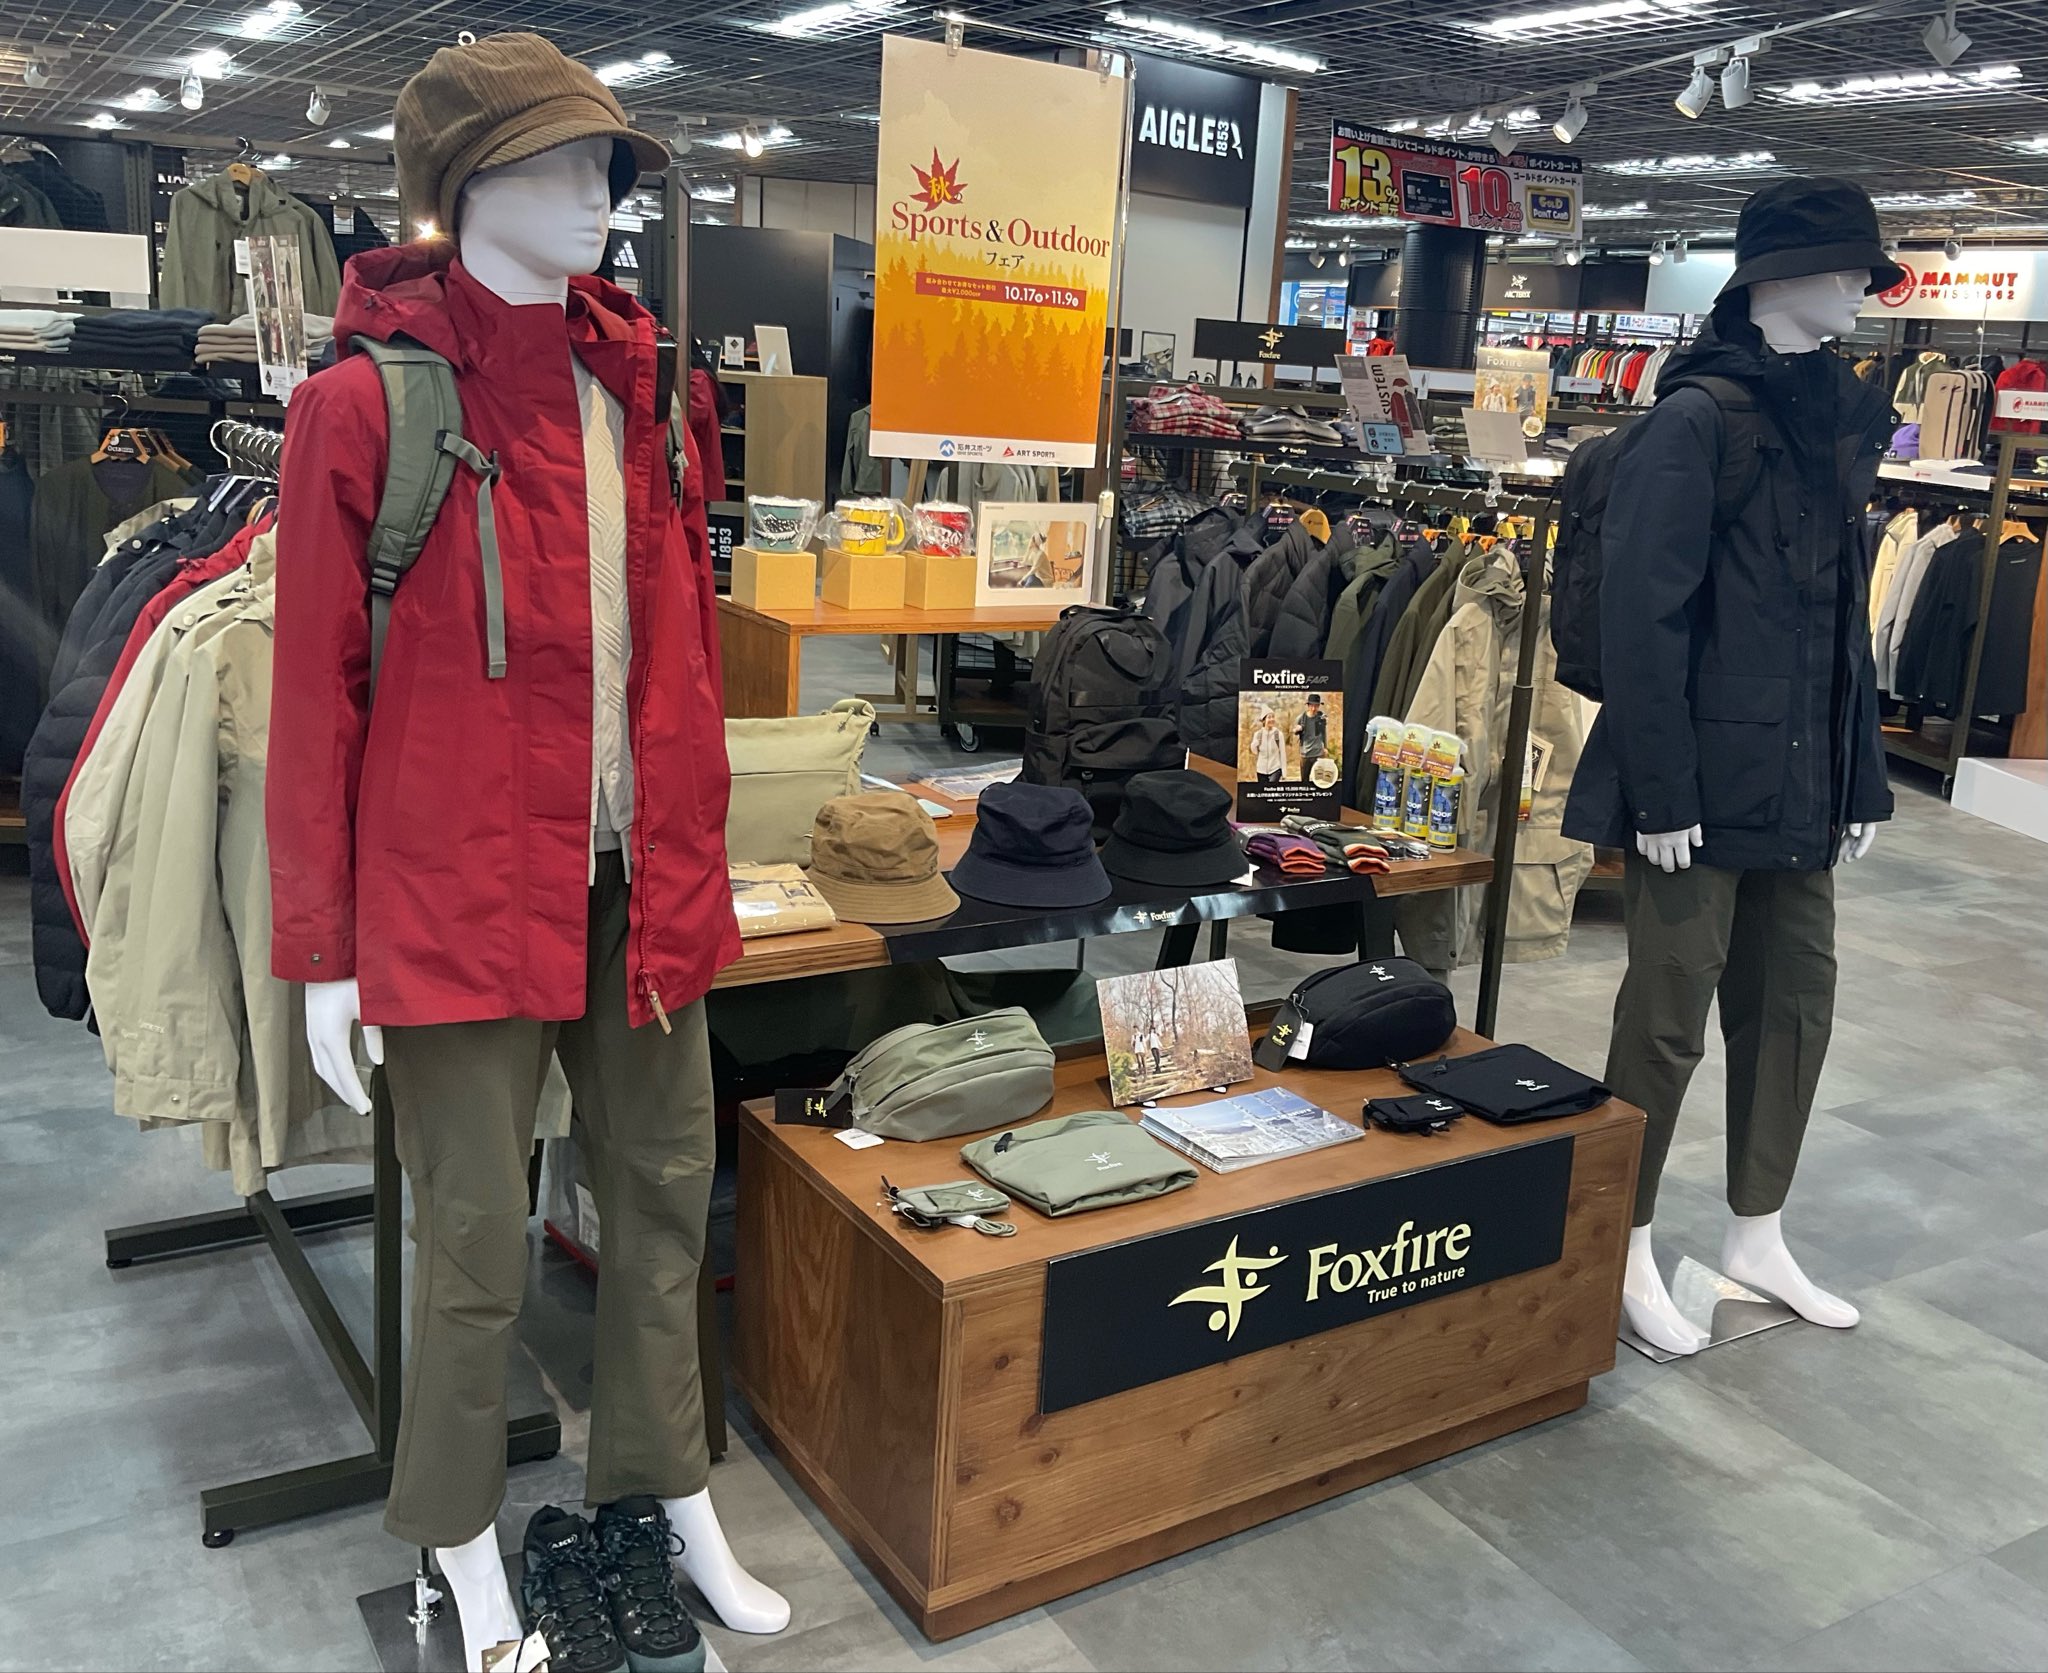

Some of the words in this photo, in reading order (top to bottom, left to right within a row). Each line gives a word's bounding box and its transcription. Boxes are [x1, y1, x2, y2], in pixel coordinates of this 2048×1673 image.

[1139, 106, 1216, 155] AIGLE
[1215, 121, 1230, 157] 1853
[1336, 145, 1400, 204] 13%
[1459, 166, 1523, 221] 10%
[891, 201, 982, 242] Sports
[986, 219, 1004, 244] &
[1007, 218, 1110, 258] Outdoor
[986, 252, 1025, 269] フェア
[1921, 272, 2018, 287] MAMMUT
[1258, 350, 1281, 360] Foxfire
[957, 443, 993, 453] 石井スポーツ
[1016, 449, 1031, 457] ART
[1032, 449, 1056, 458] SPORTS
[719, 528, 732, 558] 1853
[1253, 669, 1306, 685] Foxfire
[1150, 910, 1176, 921] Foxfire
[1306, 1220, 1471, 1302] Foxfire
[1367, 1288, 1398, 1304] True
[1402, 1280, 1416, 1294] to
[1420, 1266, 1466, 1289] nature
[638, 1514, 656, 1524] KU
[552, 1536, 575, 1549] AKU
